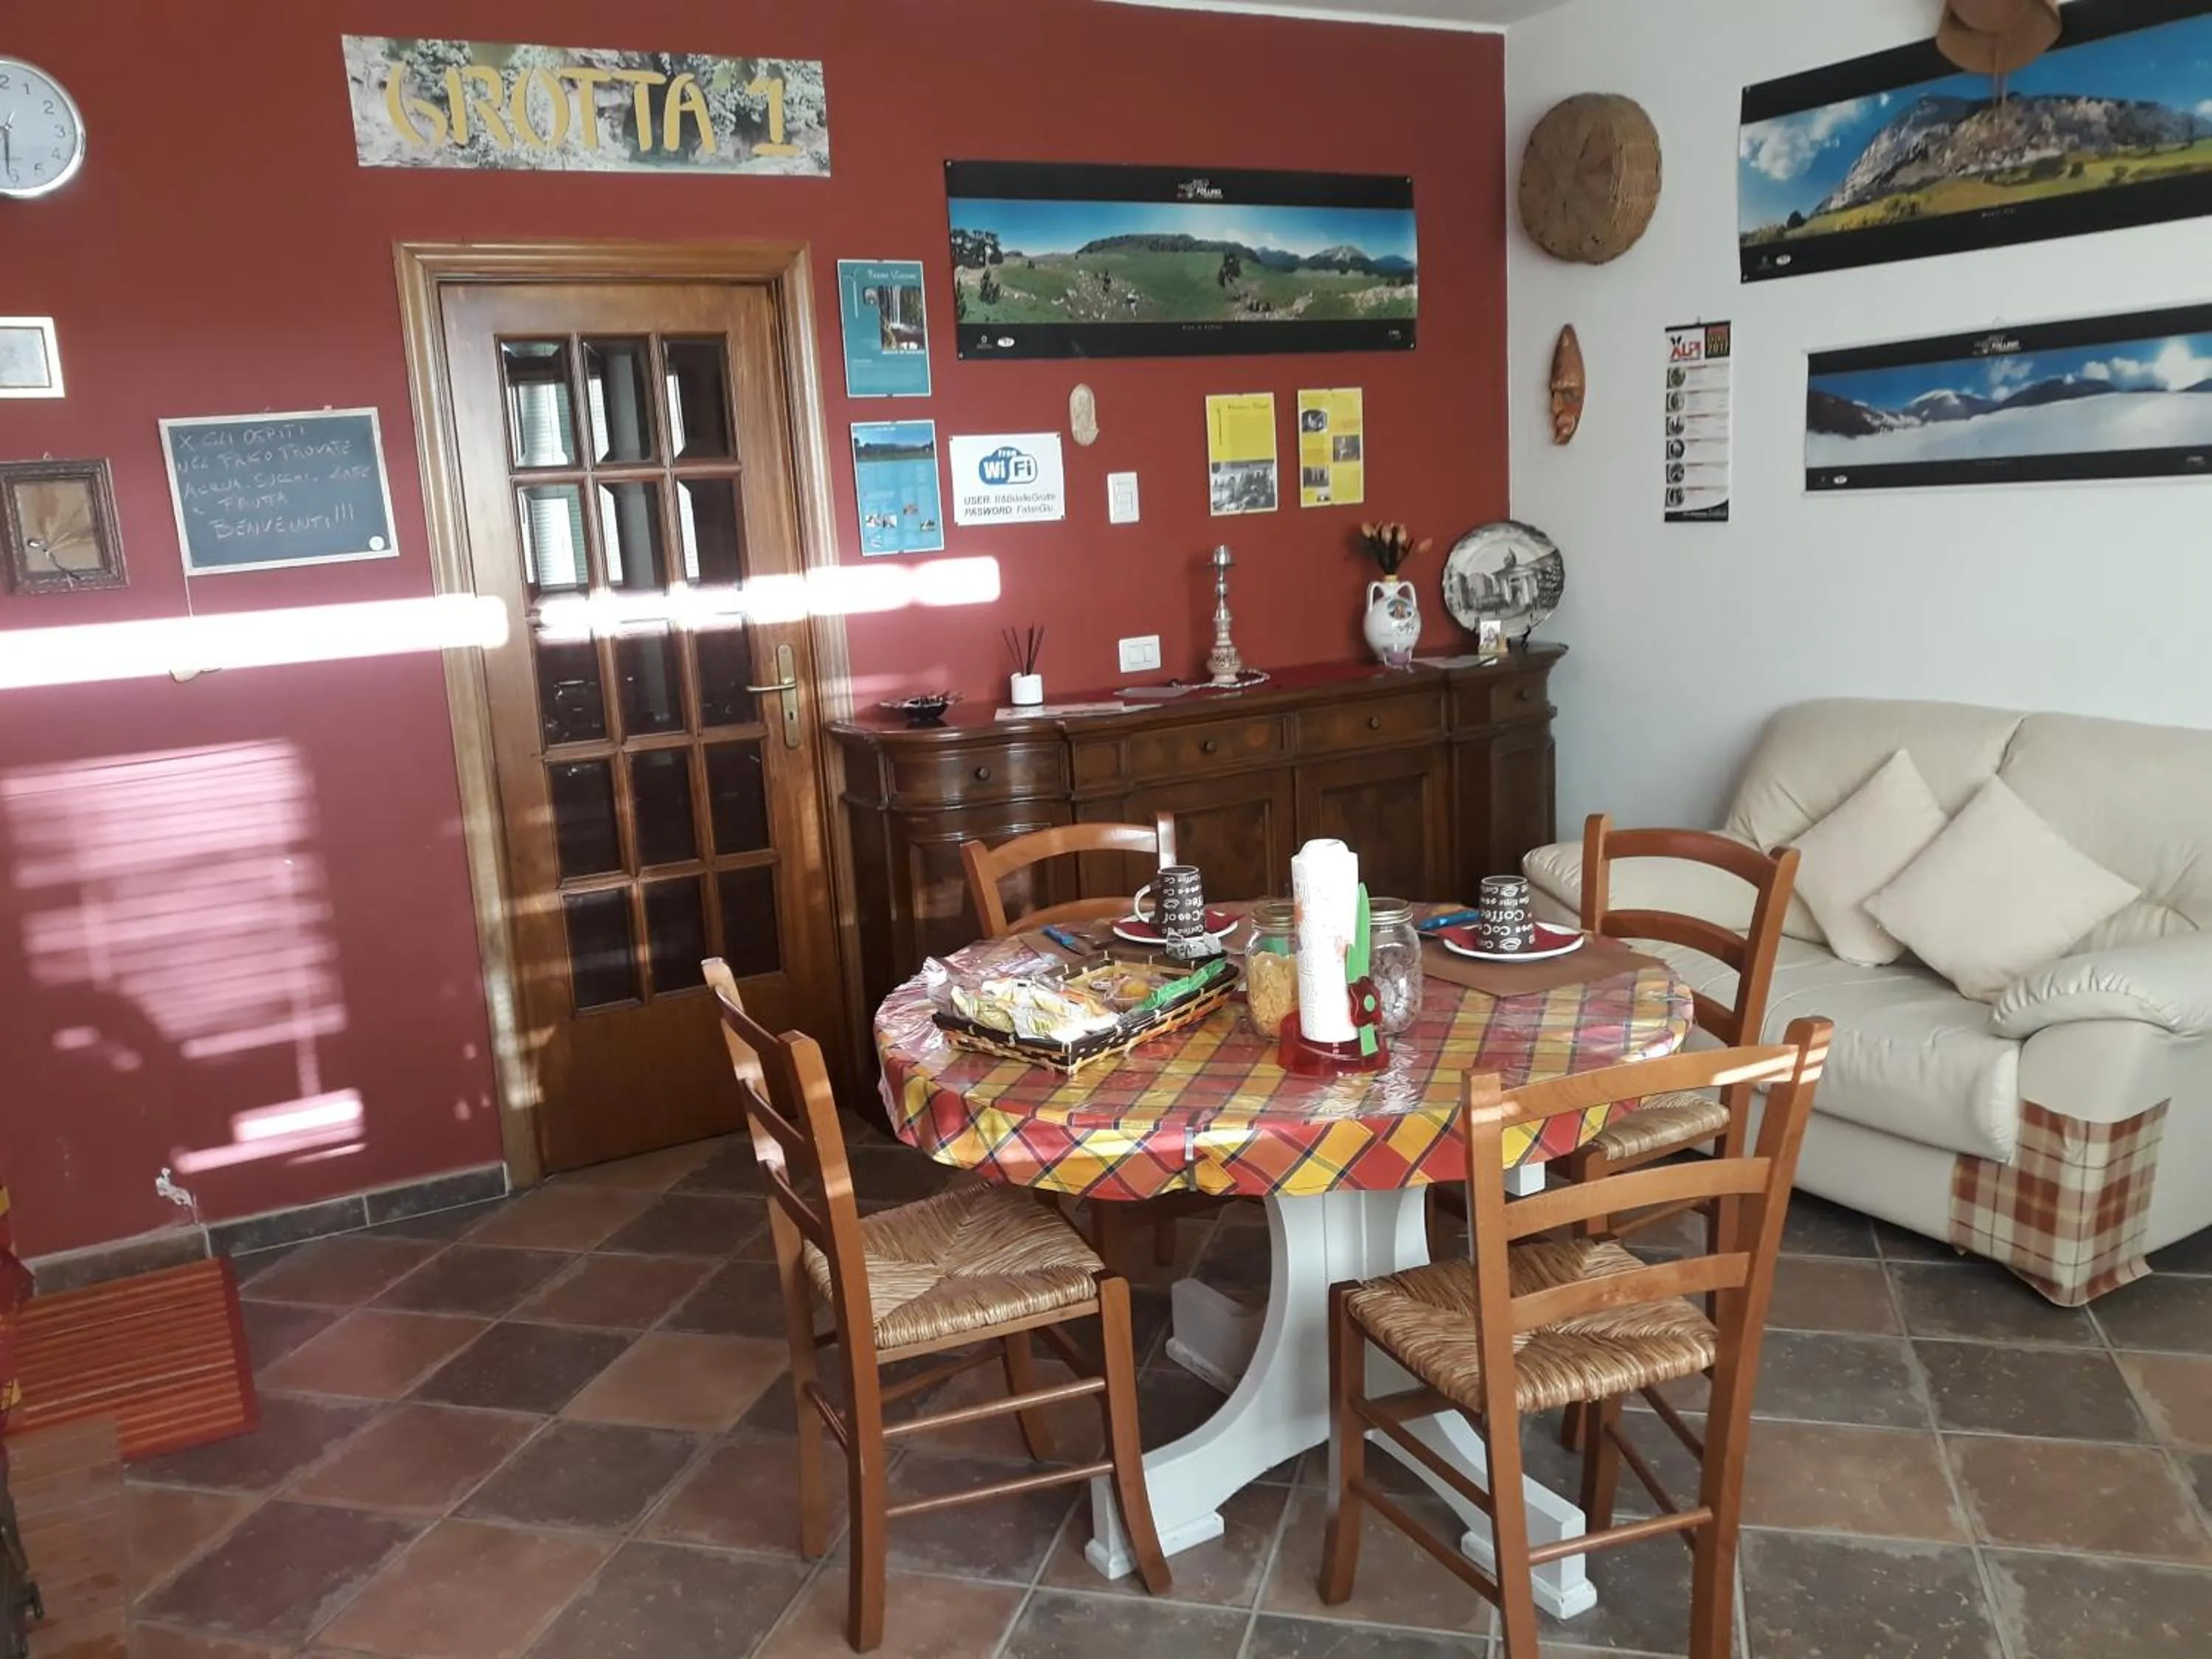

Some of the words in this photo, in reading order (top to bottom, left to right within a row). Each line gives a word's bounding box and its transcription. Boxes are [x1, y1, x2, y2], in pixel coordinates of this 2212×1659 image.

[24, 83, 29, 94] 1
[43, 100, 55, 114] 2
[386, 61, 717, 155] GROTTA
[746, 78, 802, 158] 1
[54, 124, 66, 139] 3
[178, 434, 195, 450] X
[201, 432, 233, 446] GLI
